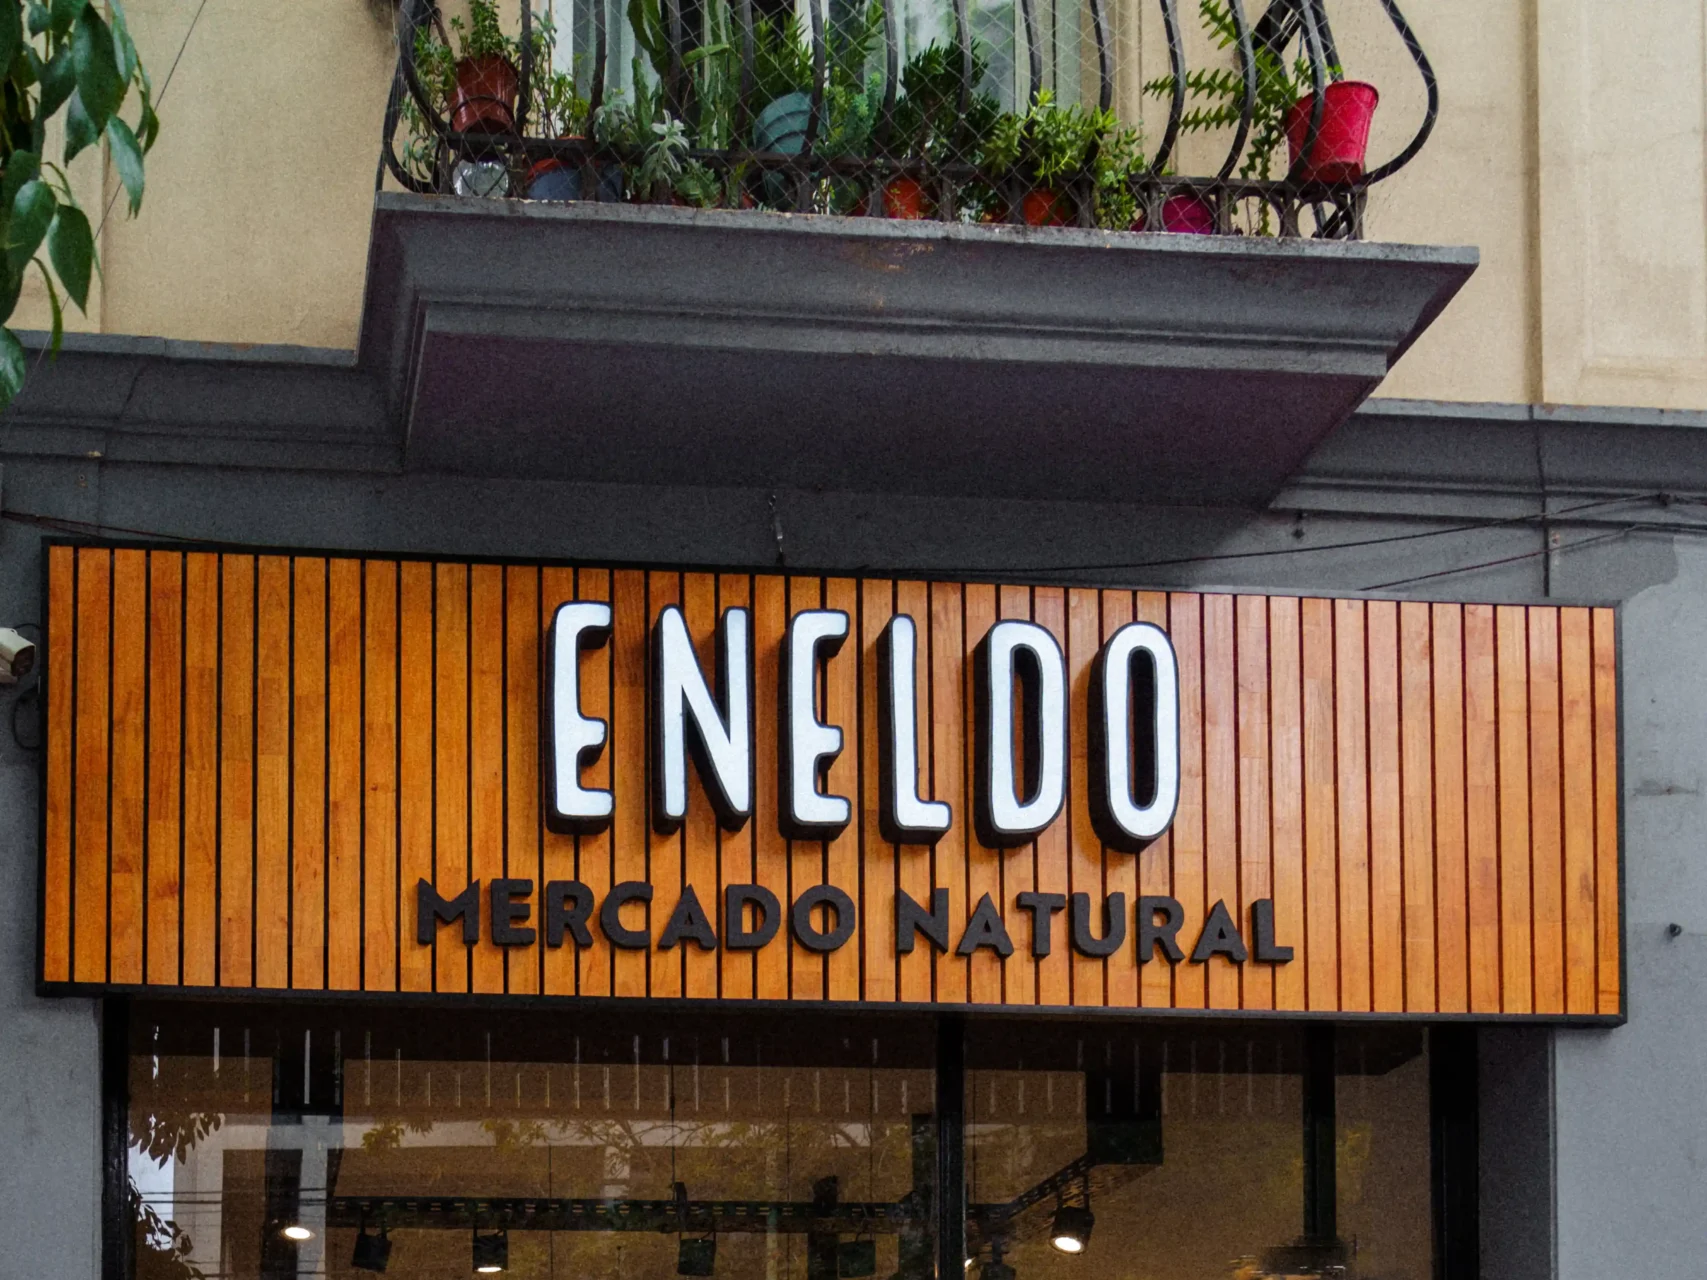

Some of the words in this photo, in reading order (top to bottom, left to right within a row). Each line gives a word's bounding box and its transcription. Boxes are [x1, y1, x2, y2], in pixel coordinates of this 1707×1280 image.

[547, 601, 1181, 853] ENELDO
[417, 876, 856, 953] MERCADO
[894, 887, 1295, 965] NATURAL
